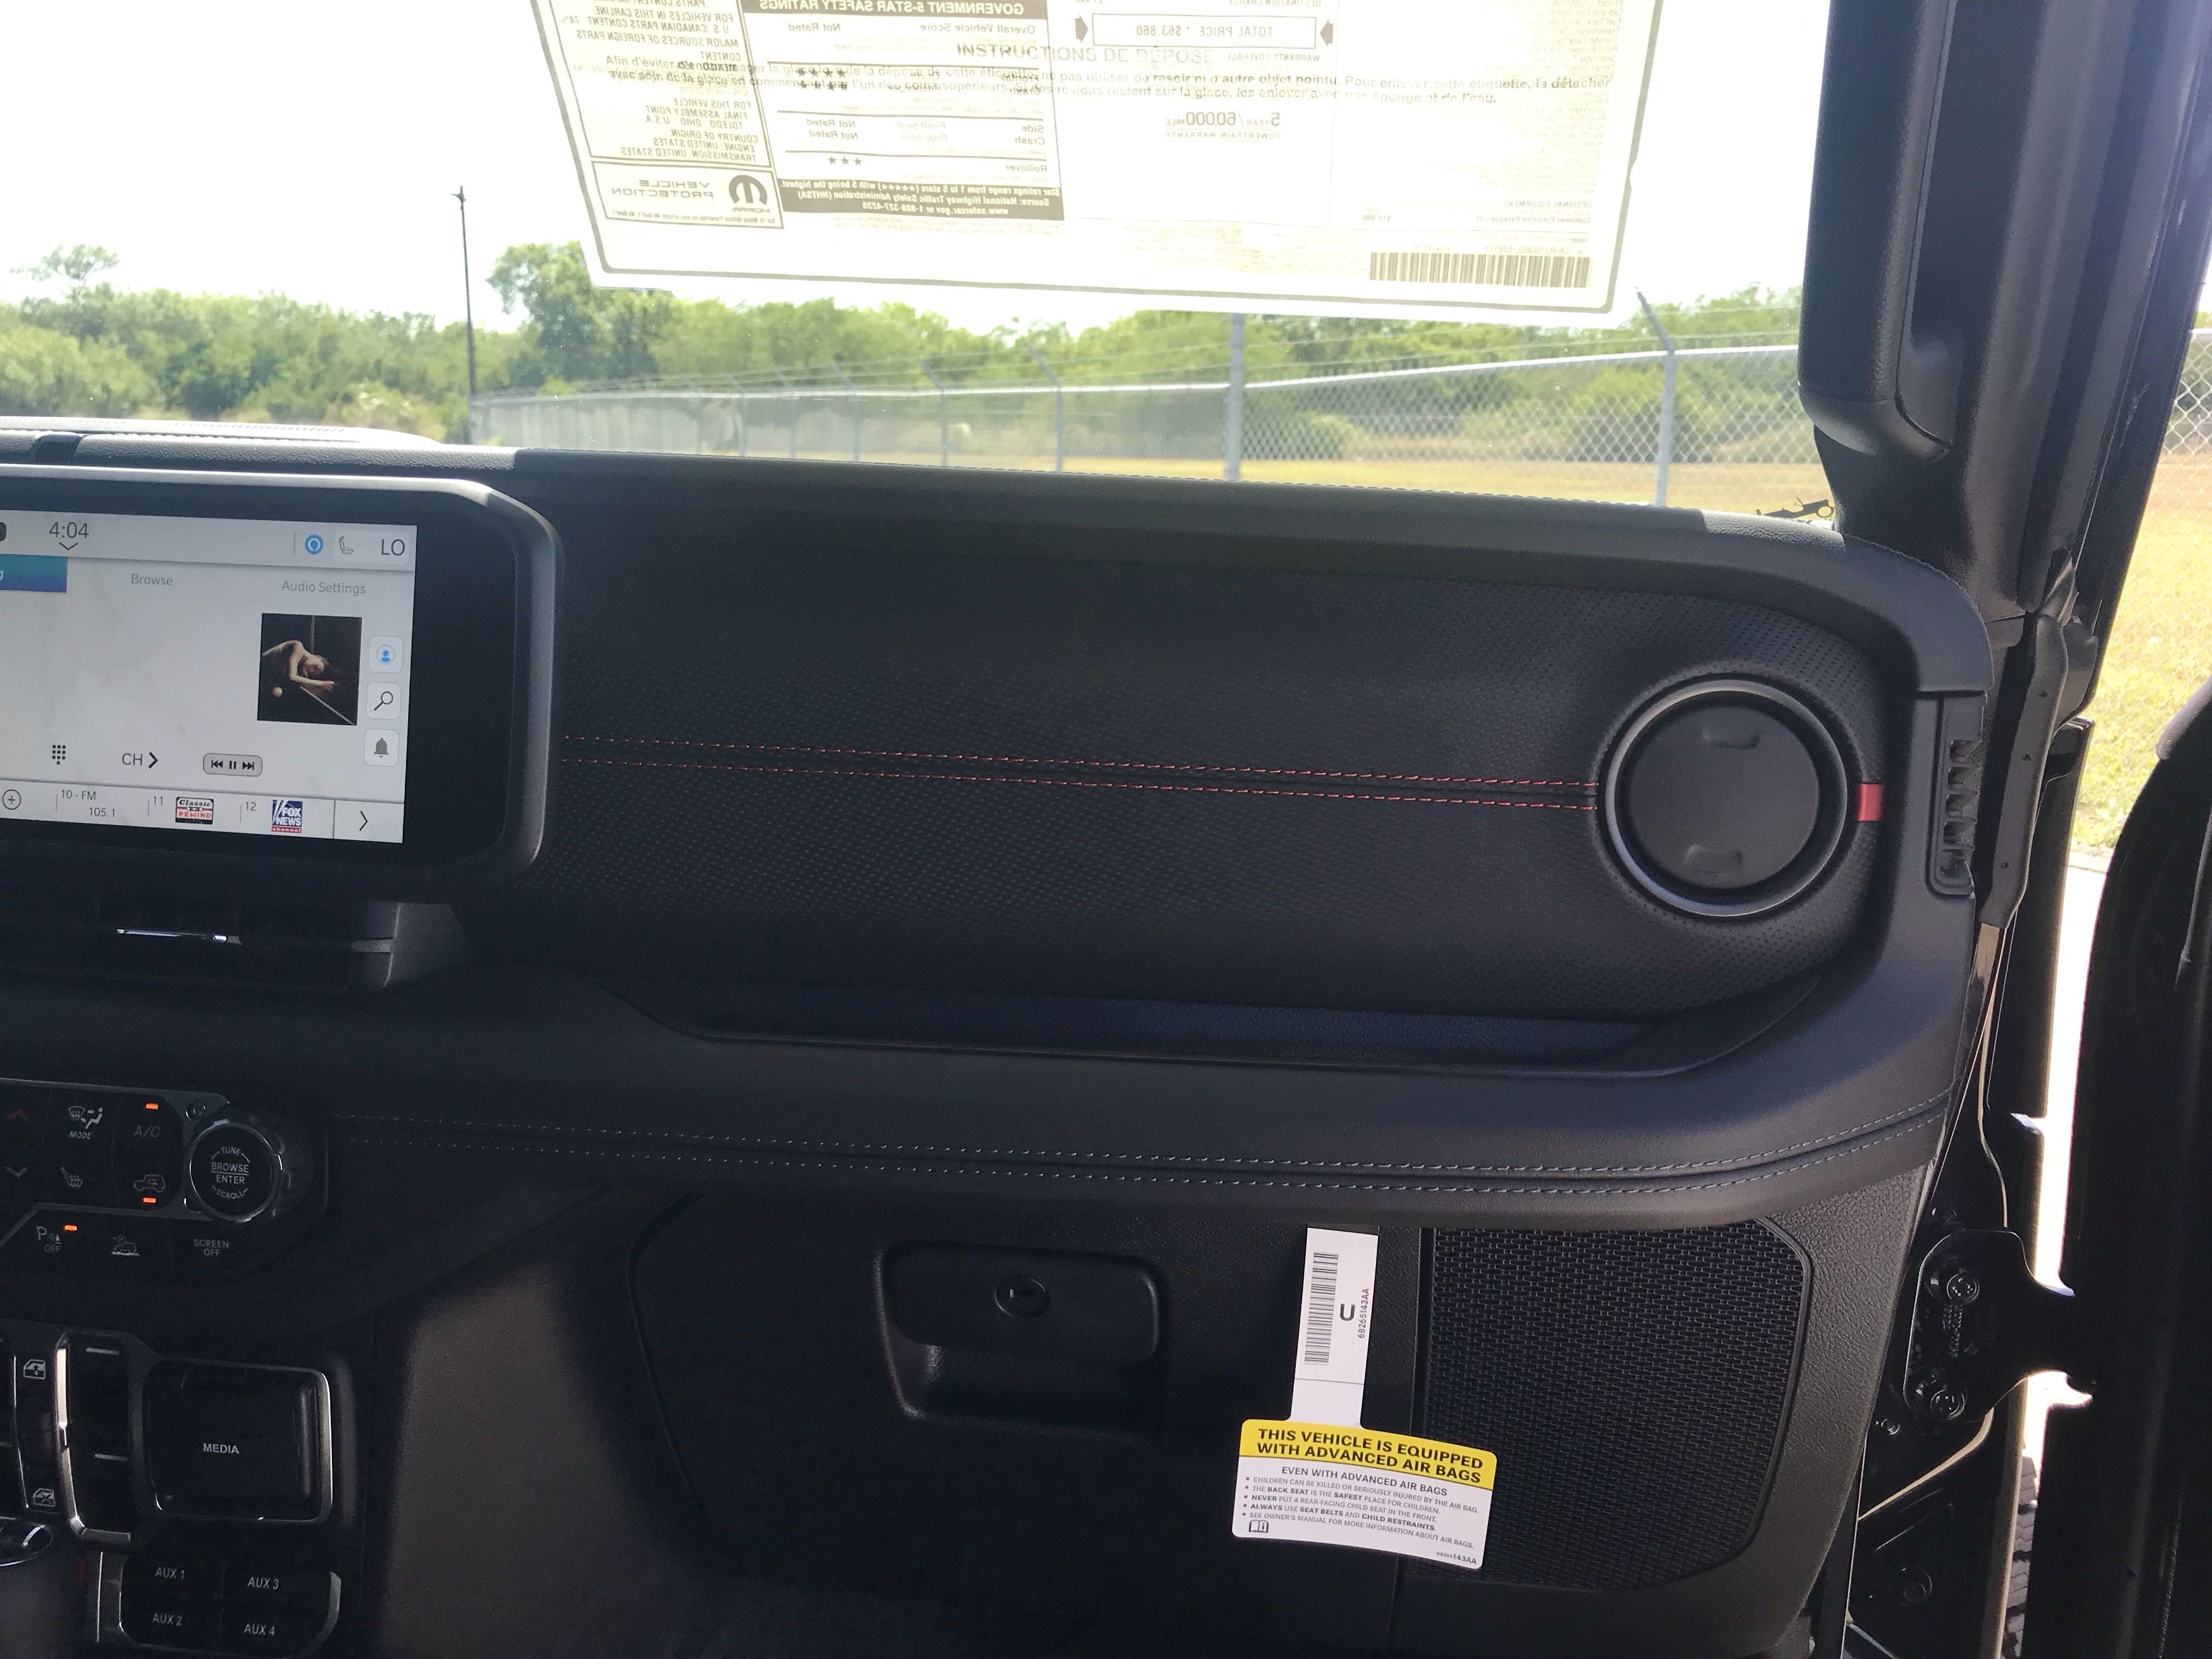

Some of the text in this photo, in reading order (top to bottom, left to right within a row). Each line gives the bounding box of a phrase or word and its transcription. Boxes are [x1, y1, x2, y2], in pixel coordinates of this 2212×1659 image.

[957, 43, 1097, 62] INSTRUCTIONS
[1104, 48, 1129, 63] DE
[606, 55, 628, 66] Afin
[632, 57, 673, 69] d'éviter
[946, 67, 975, 77] cette
[1060, 72, 1082, 83] pas
[1210, 73, 1255, 83] d'autre
[1259, 74, 1292, 87] objet
[1345, 76, 1374, 87] Pour
[1551, 78, 1611, 89] détacher
[49, 522, 88, 539] 4:04
[381, 539, 405, 556] LO
[131, 574, 173, 586] Browse
[281, 580, 365, 596] Audio Settings
[122, 753, 143, 767] CH
[61, 790, 72, 799] 10
[82, 791, 96, 800] FM
[154, 796, 163, 805] 11
[179, 799, 211, 807] Classic
[246, 802, 256, 811] 12
[89, 807, 115, 817] 105.1
[282, 808, 301, 817] FOX
[276, 817, 301, 826] NEWS
[69, 1131, 92, 1139] MODE
[133, 1125, 160, 1138] A/C
[221, 1147, 241, 1155] TUNE
[212, 1162, 249, 1173] BROWSE
[216, 1175, 245, 1184] ENTER
[216, 1189, 245, 1199] SCROLL
[37, 1226, 47, 1240] P
[44, 1244, 61, 1253] OFF
[193, 1239, 229, 1248] SCREEN
[1340, 1304, 1355, 1321] U
[1357, 1288, 1369, 1338] 68265143AA
[203, 1443, 240, 1454] MEDIA
[1259, 1429, 1483, 1469] THIS VEHICLE IS EQUIPPED
[1257, 1442, 1481, 1483] WITH ADVANCED AIR BAGS
[1282, 1466, 1447, 1496] EVEN WITH ADVANCED AIR BAGS
[1334, 1492, 1362, 1500] SAFEST
[1403, 1502, 1440, 1514] CHILDREN.
[1354, 1486, 1391, 1496] SERIOUSLY
[1393, 1491, 1422, 1502] INJURED
[1463, 1505, 1479, 1514] BAG.
[1300, 1498, 1345, 1508] REAR-FACING
[1413, 1513, 1437, 1522] FRONT.
[1362, 1514, 1385, 1522] CHILD
[1387, 1517, 1436, 1531] RESTRAINTS.
[1297, 1515, 1327, 1523] MANUAL
[1365, 1523, 1414, 1536] INFORMATION
[1415, 1531, 1439, 1541] ABOUT
[1454, 1539, 1474, 1548] BAGS.
[1436, 1551, 1476, 1564] 68265143AA
[155, 1567, 185, 1580] AUX 1
[248, 1576, 279, 1590] AUX 3
[153, 1613, 182, 1626] AUX 2
[244, 1624, 275, 1636] AUX 4
